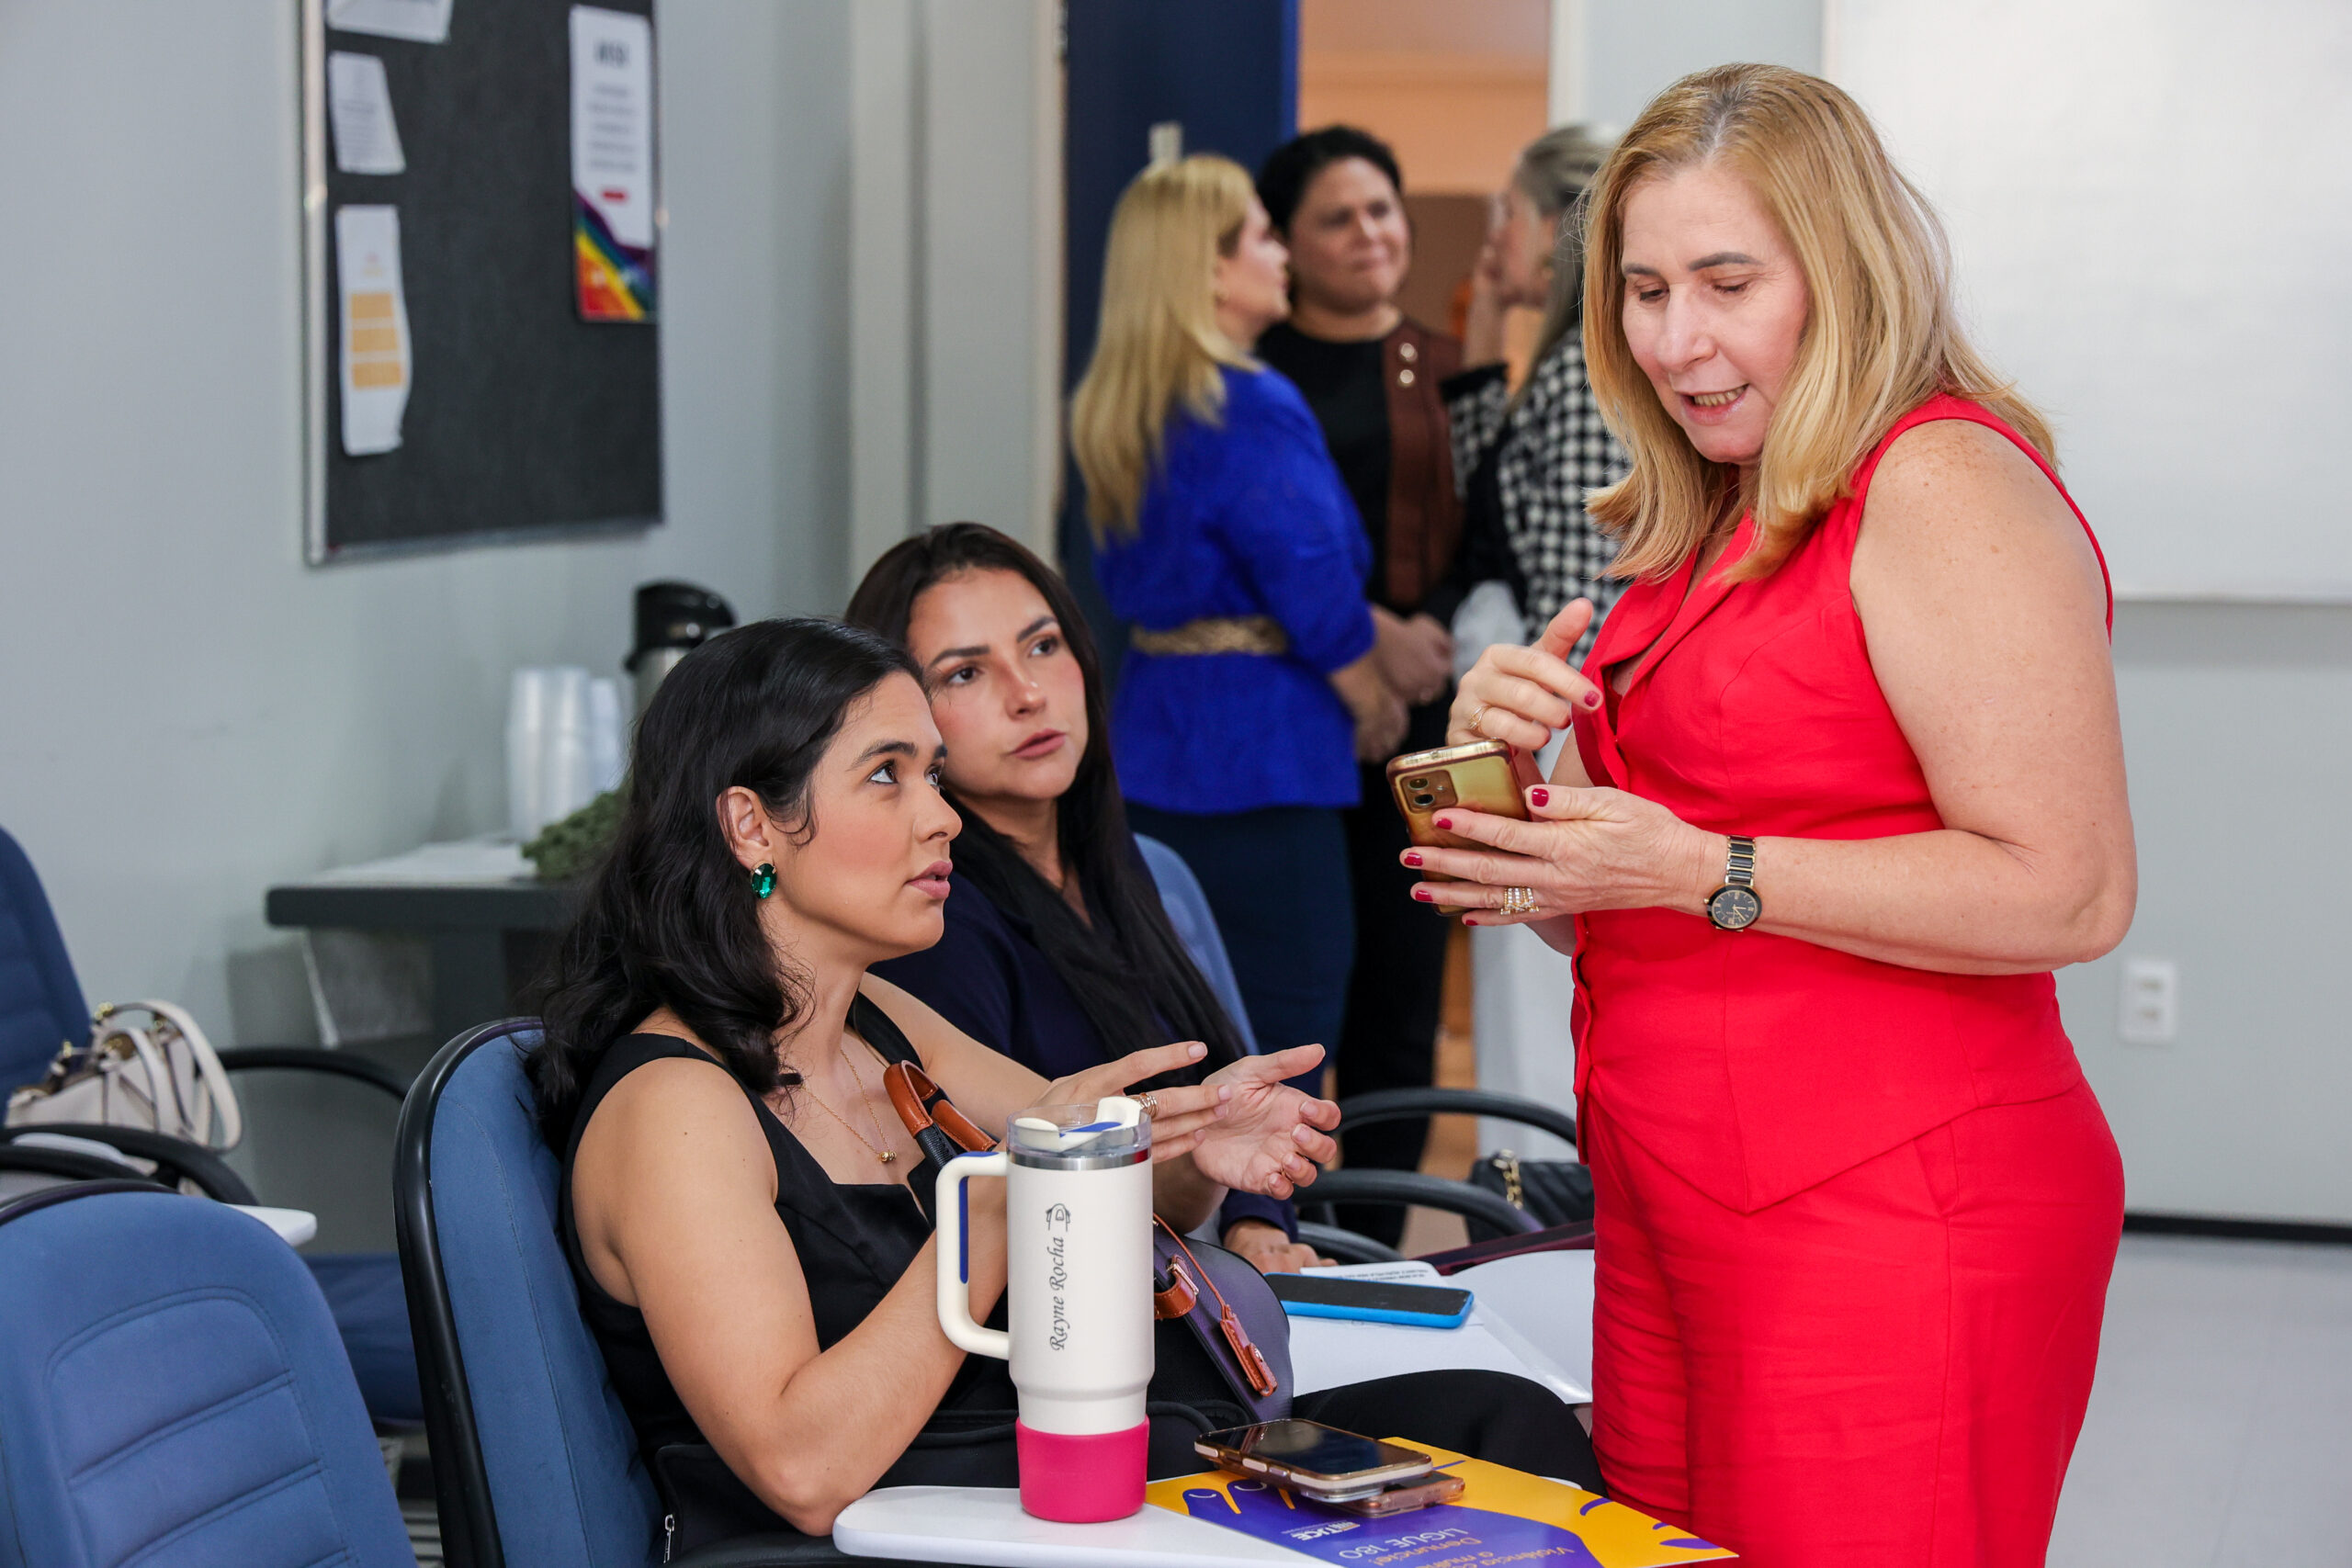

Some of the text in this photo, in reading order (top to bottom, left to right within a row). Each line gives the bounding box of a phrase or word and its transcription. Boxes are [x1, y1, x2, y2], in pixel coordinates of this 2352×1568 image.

[1046, 1236, 1070, 1351] Rayne Rocha
[1339, 1528, 1469, 1559] LIGUE 180
